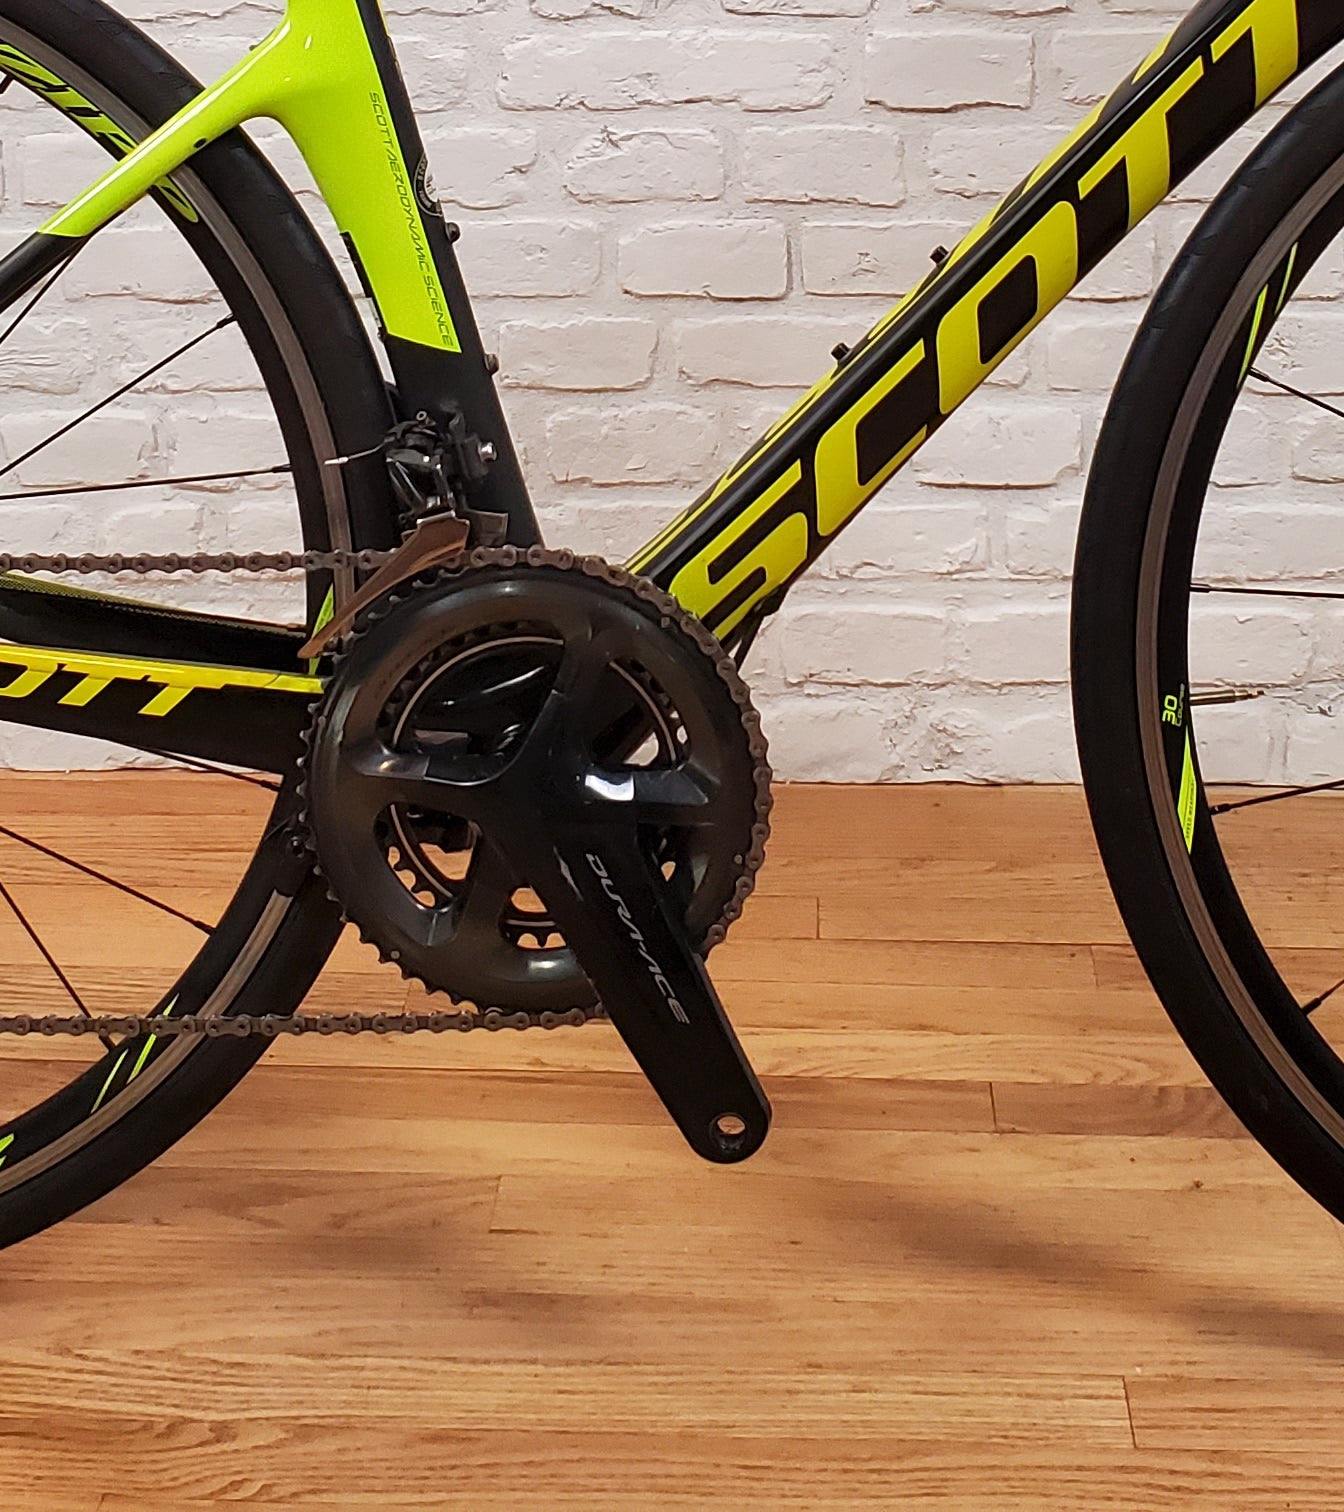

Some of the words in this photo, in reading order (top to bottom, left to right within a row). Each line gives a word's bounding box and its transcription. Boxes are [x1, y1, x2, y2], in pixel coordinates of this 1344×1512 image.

[368, 92, 394, 149] SCOTT
[385, 149, 430, 269] AERODYNAMIC
[422, 276, 454, 346] SCIENCE
[1162, 694, 1178, 726] 30
